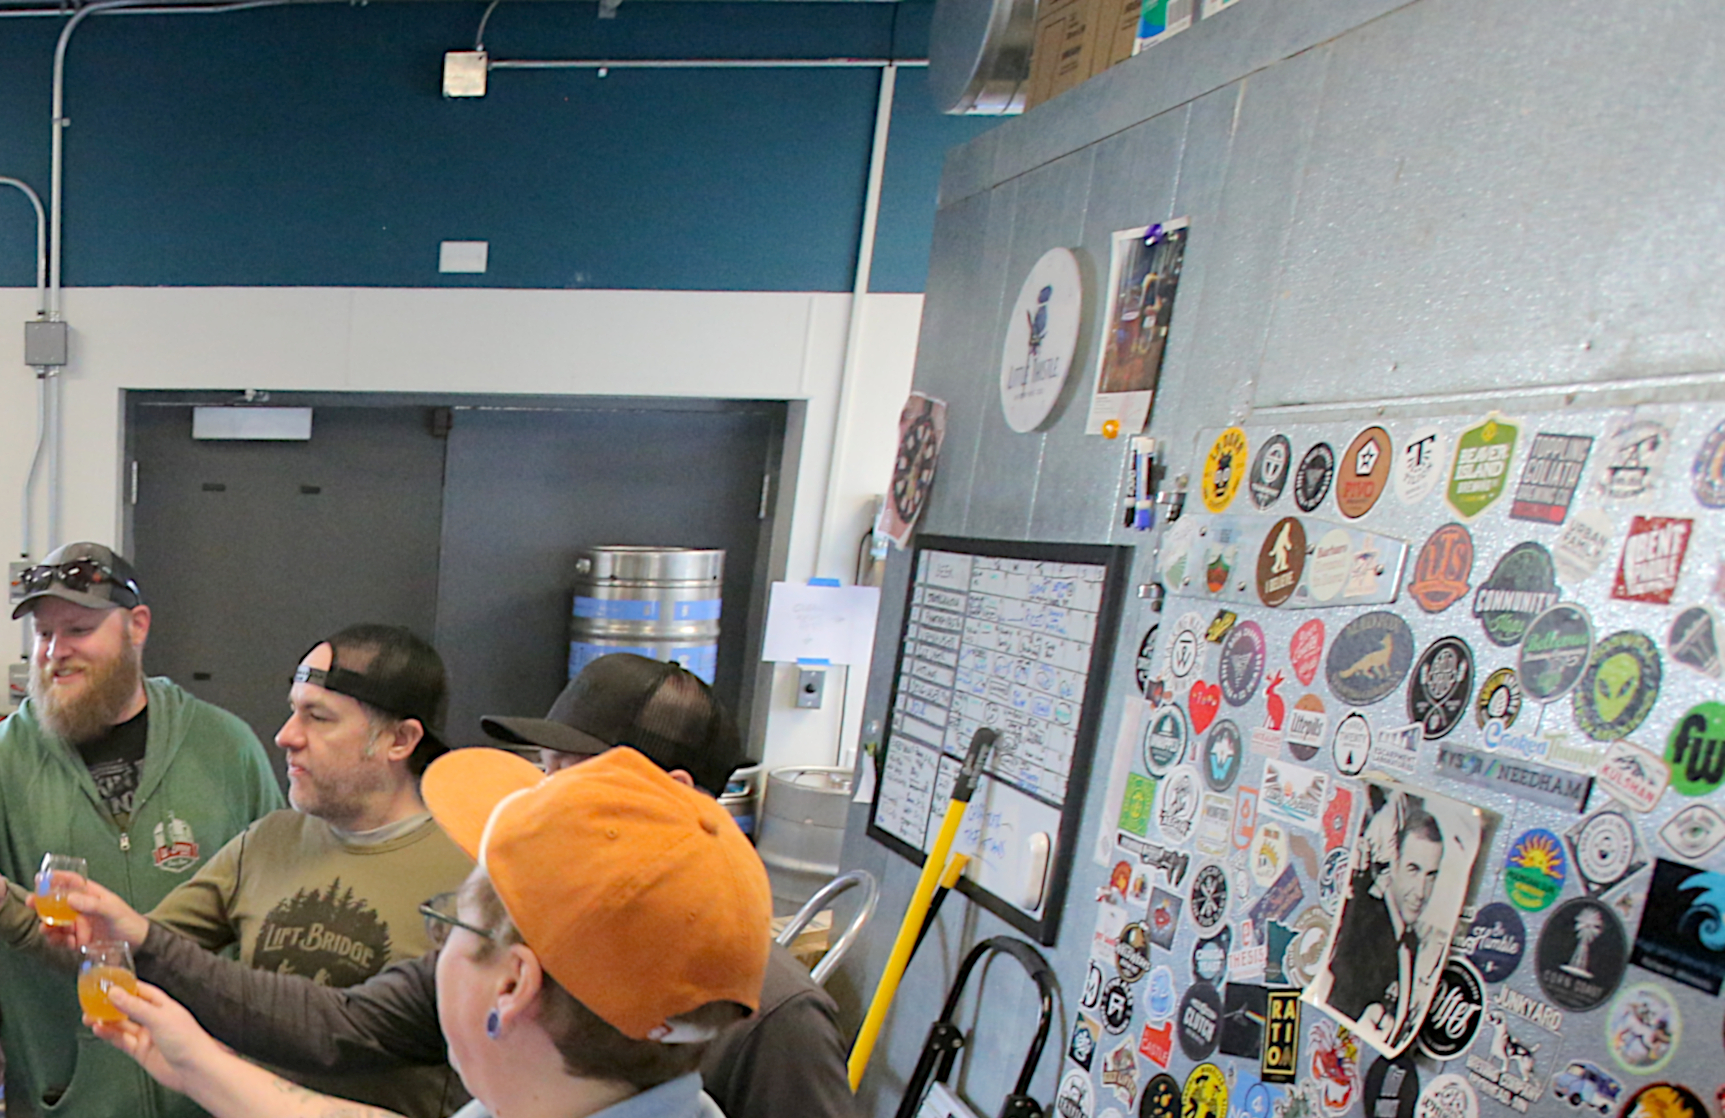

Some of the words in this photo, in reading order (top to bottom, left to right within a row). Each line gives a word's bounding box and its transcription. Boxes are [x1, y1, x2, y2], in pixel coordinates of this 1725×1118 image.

[1454, 460, 1505, 481] ISLAND
[1497, 763, 1583, 800] NEEDHAM
[1601, 765, 1656, 803] KULSHAN
[264, 922, 306, 952] LIFT
[301, 922, 375, 969] BRIDGE
[1229, 945, 1268, 968] THESIS
[1493, 984, 1564, 1032] JUNKYARD
